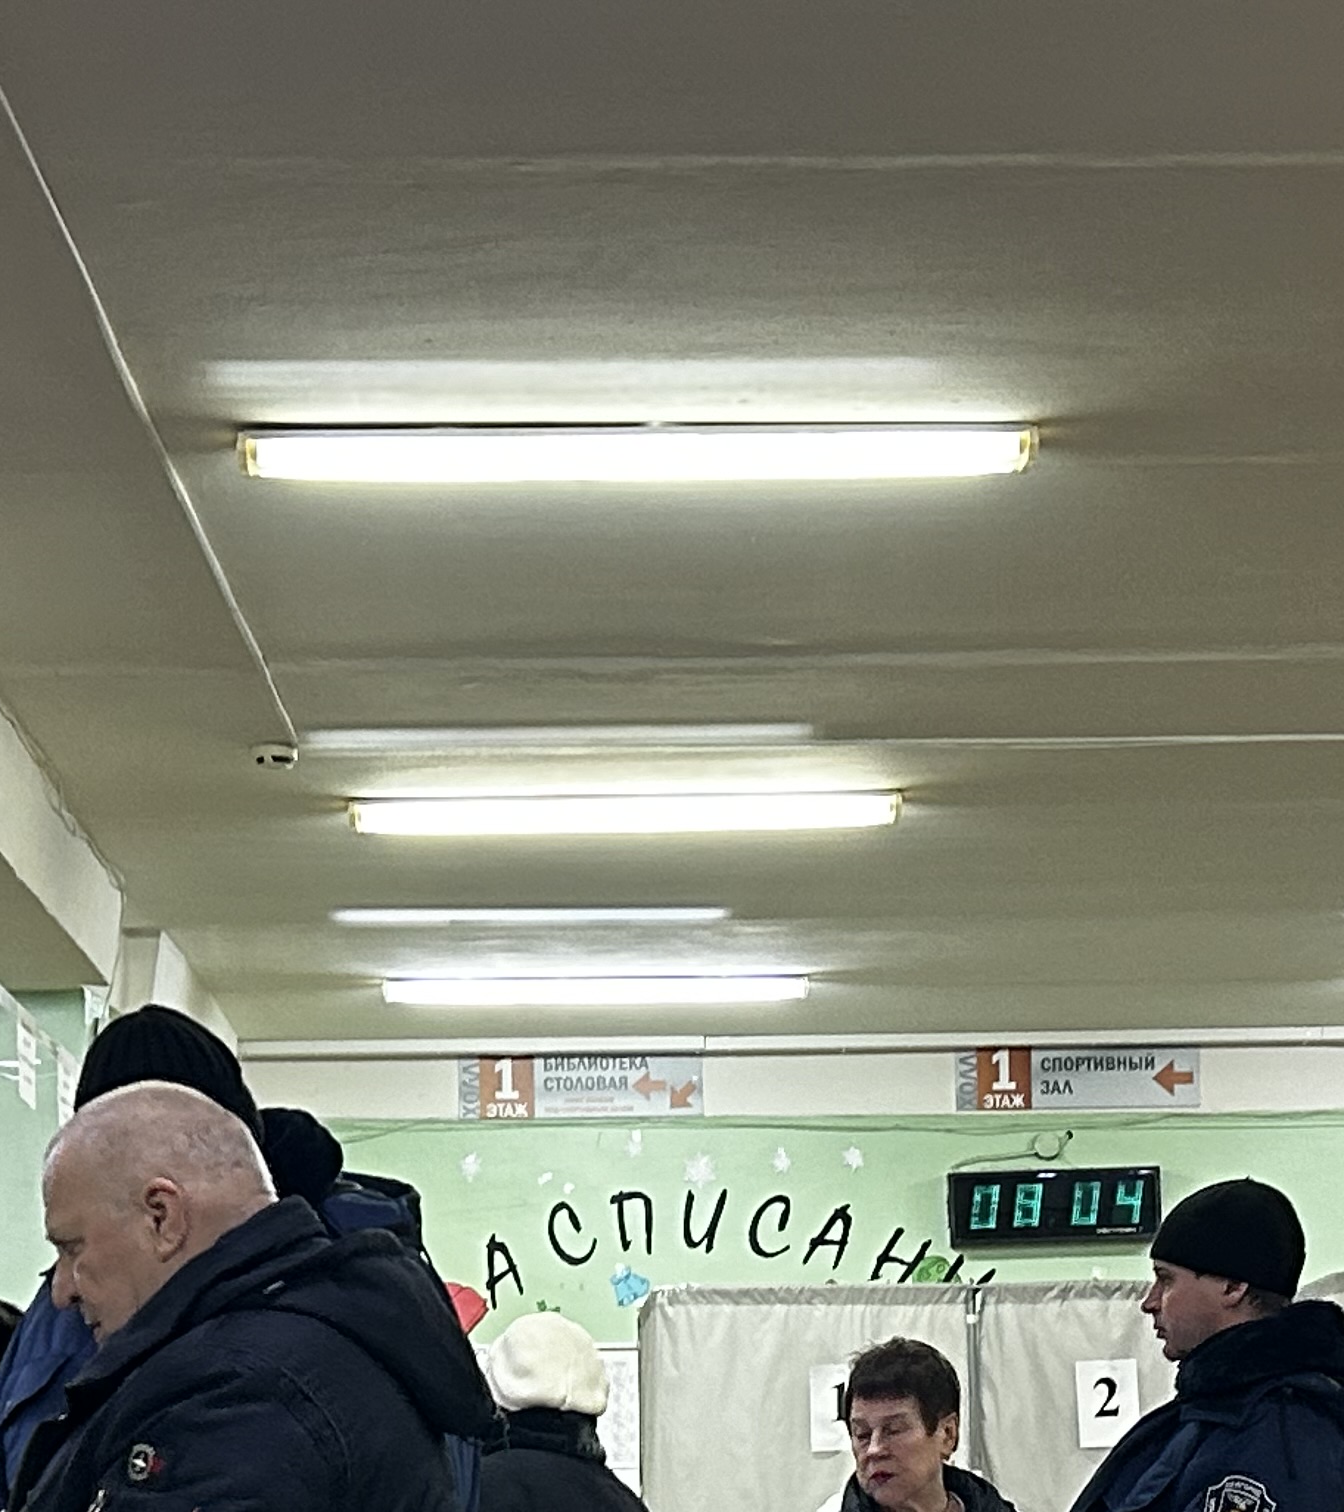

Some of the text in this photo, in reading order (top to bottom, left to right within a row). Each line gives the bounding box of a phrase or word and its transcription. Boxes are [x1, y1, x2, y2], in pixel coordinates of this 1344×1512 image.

[543, 1057, 650, 1073] БИБЛИОТЕКА
[991, 1049, 1017, 1091] 1
[1040, 1054, 1156, 1072] СПОРТИВНЫЙ
[493, 1057, 520, 1101] 1
[543, 1075, 629, 1092] СТОЛОВАЯ
[1040, 1079, 1074, 1096] ЗАЛ
[486, 1102, 529, 1118] ЭТАЖ
[982, 1093, 1025, 1109] ЭТАЖ
[1069, 1180, 1145, 1226] 04
[831, 1381, 847, 1423] 1
[1092, 1377, 1120, 1419] 2
